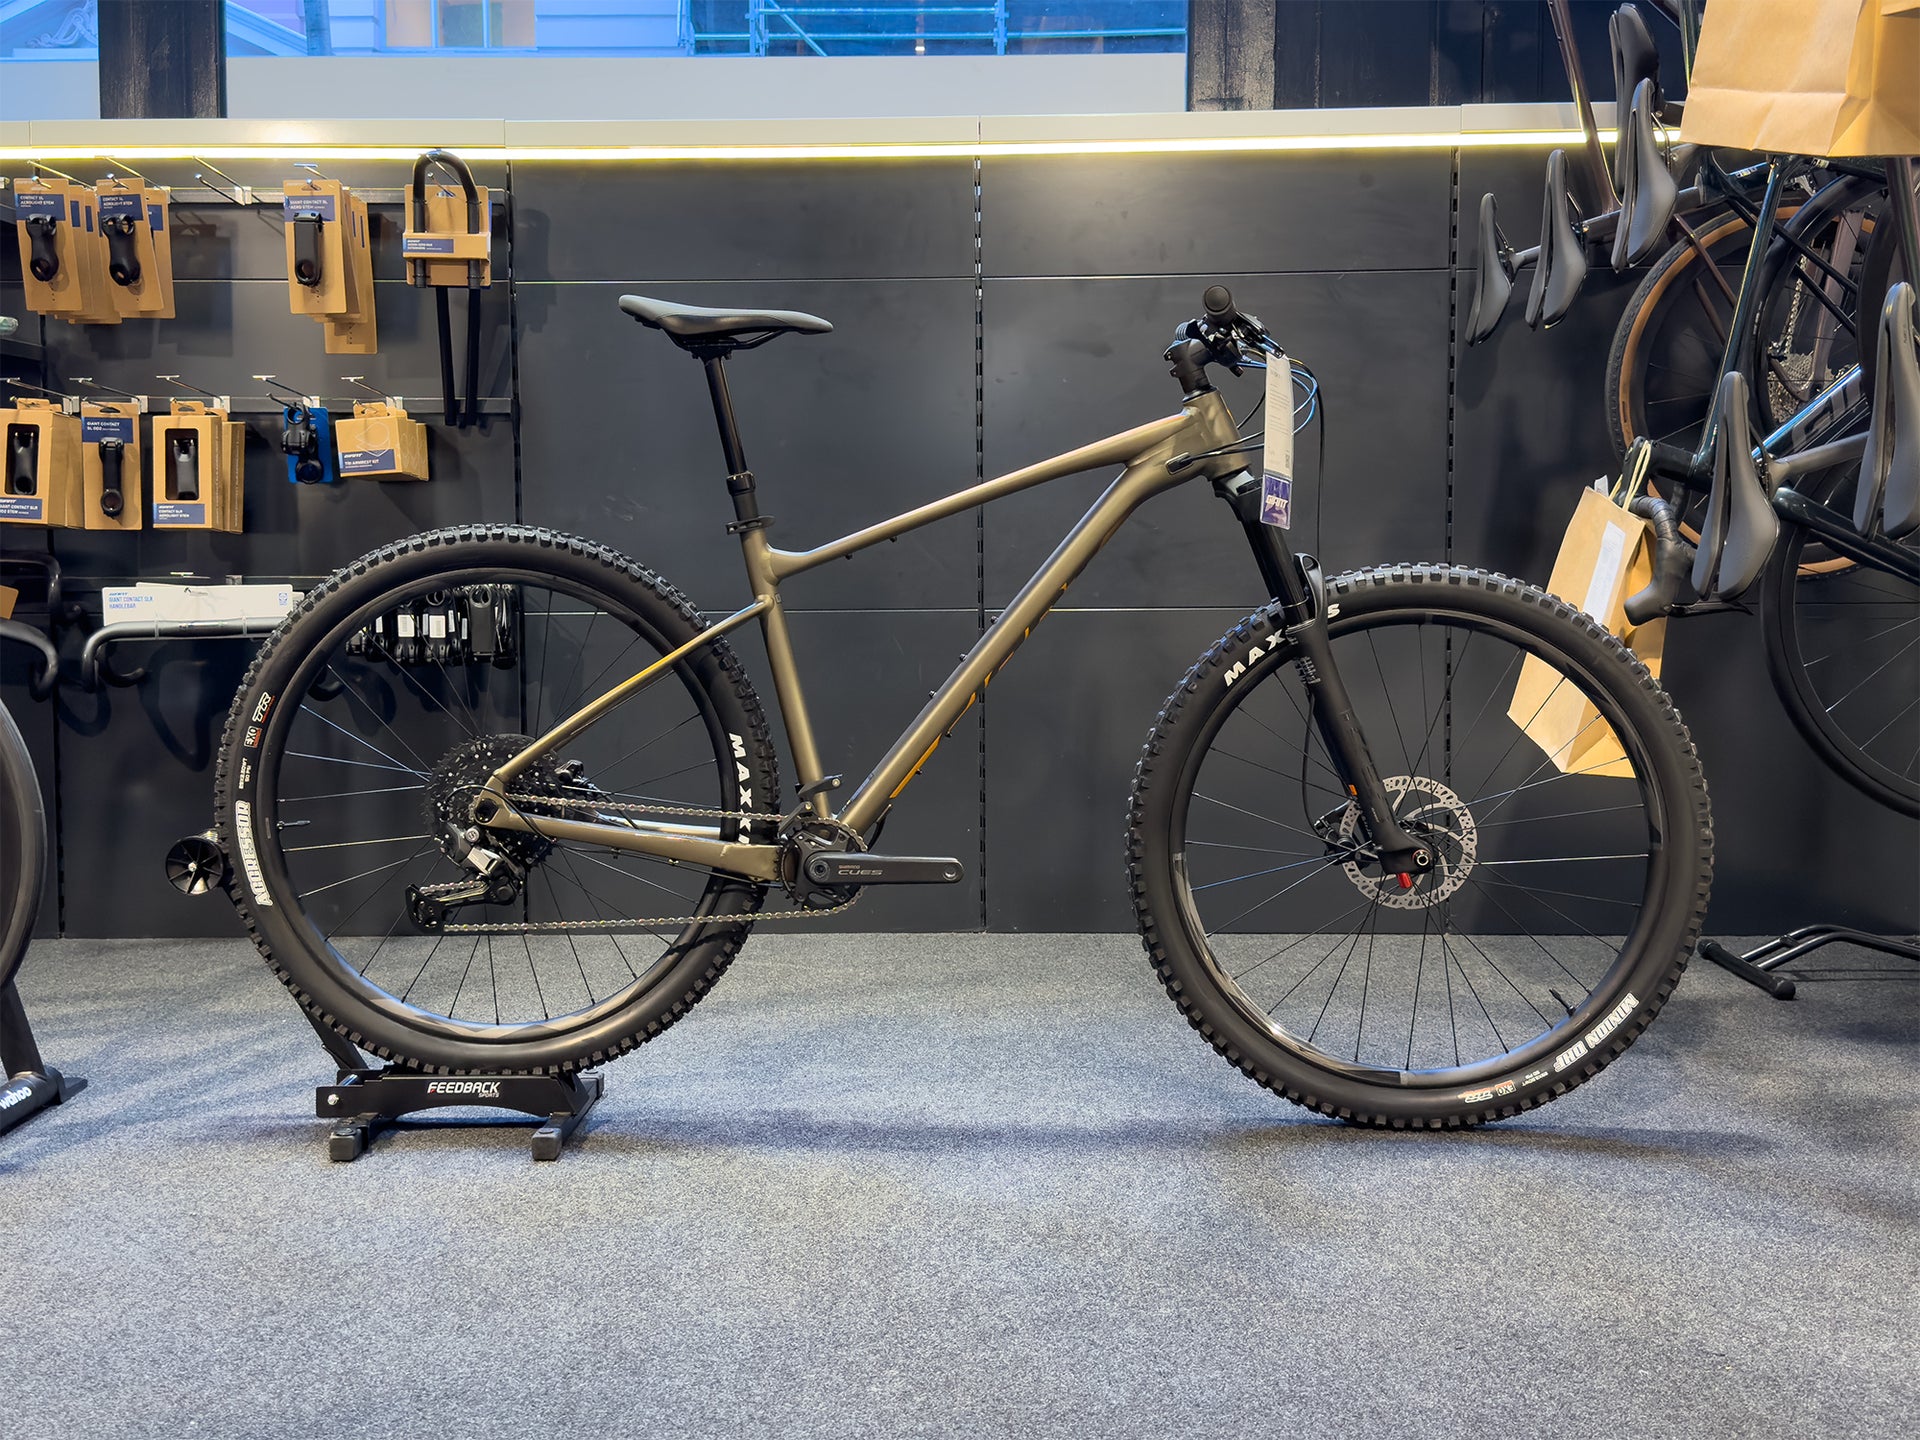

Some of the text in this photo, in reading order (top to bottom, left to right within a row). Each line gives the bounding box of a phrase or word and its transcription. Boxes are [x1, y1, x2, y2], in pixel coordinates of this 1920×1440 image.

[235, 800, 273, 906] AGGRESSOR
[1553, 992, 1640, 1073] MINION DHF
[0, 1086, 32, 1110] wahoo
[427, 1081, 500, 1094] FEEDBACK
